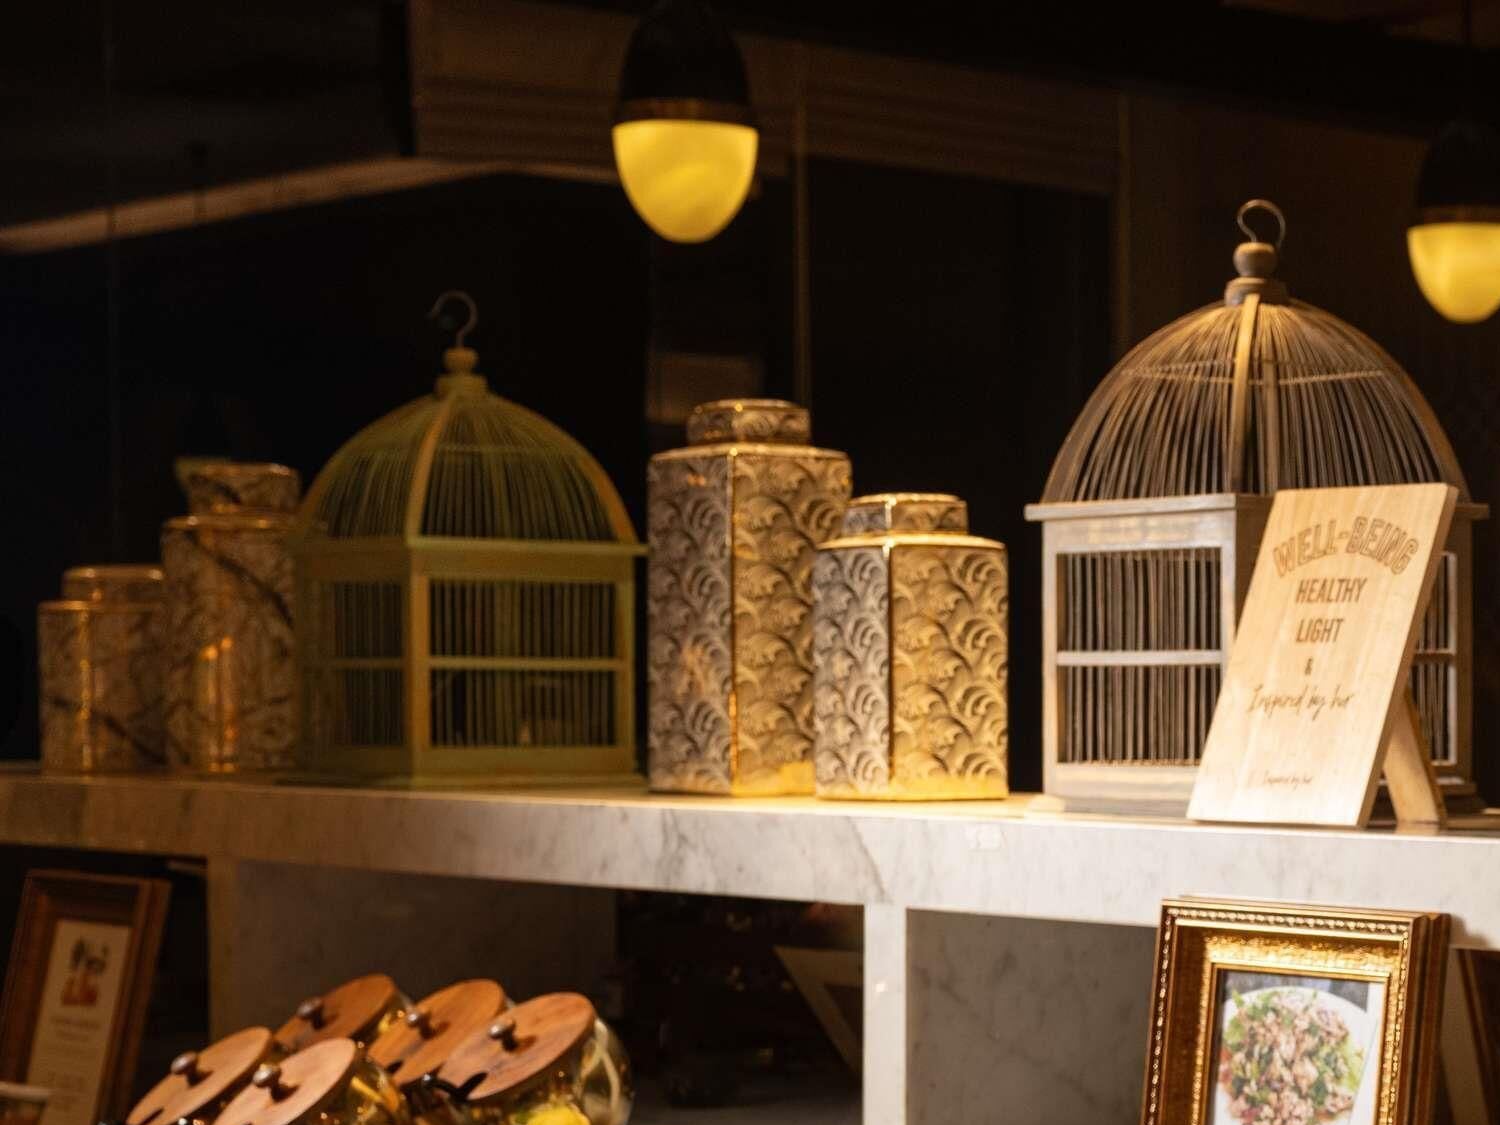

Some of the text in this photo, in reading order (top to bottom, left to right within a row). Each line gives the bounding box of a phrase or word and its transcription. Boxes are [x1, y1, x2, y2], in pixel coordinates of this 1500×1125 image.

[1273, 515, 1420, 578] WELL-BEING
[1295, 577, 1368, 604] HEALTHY
[1295, 618, 1344, 643] LIGHT
